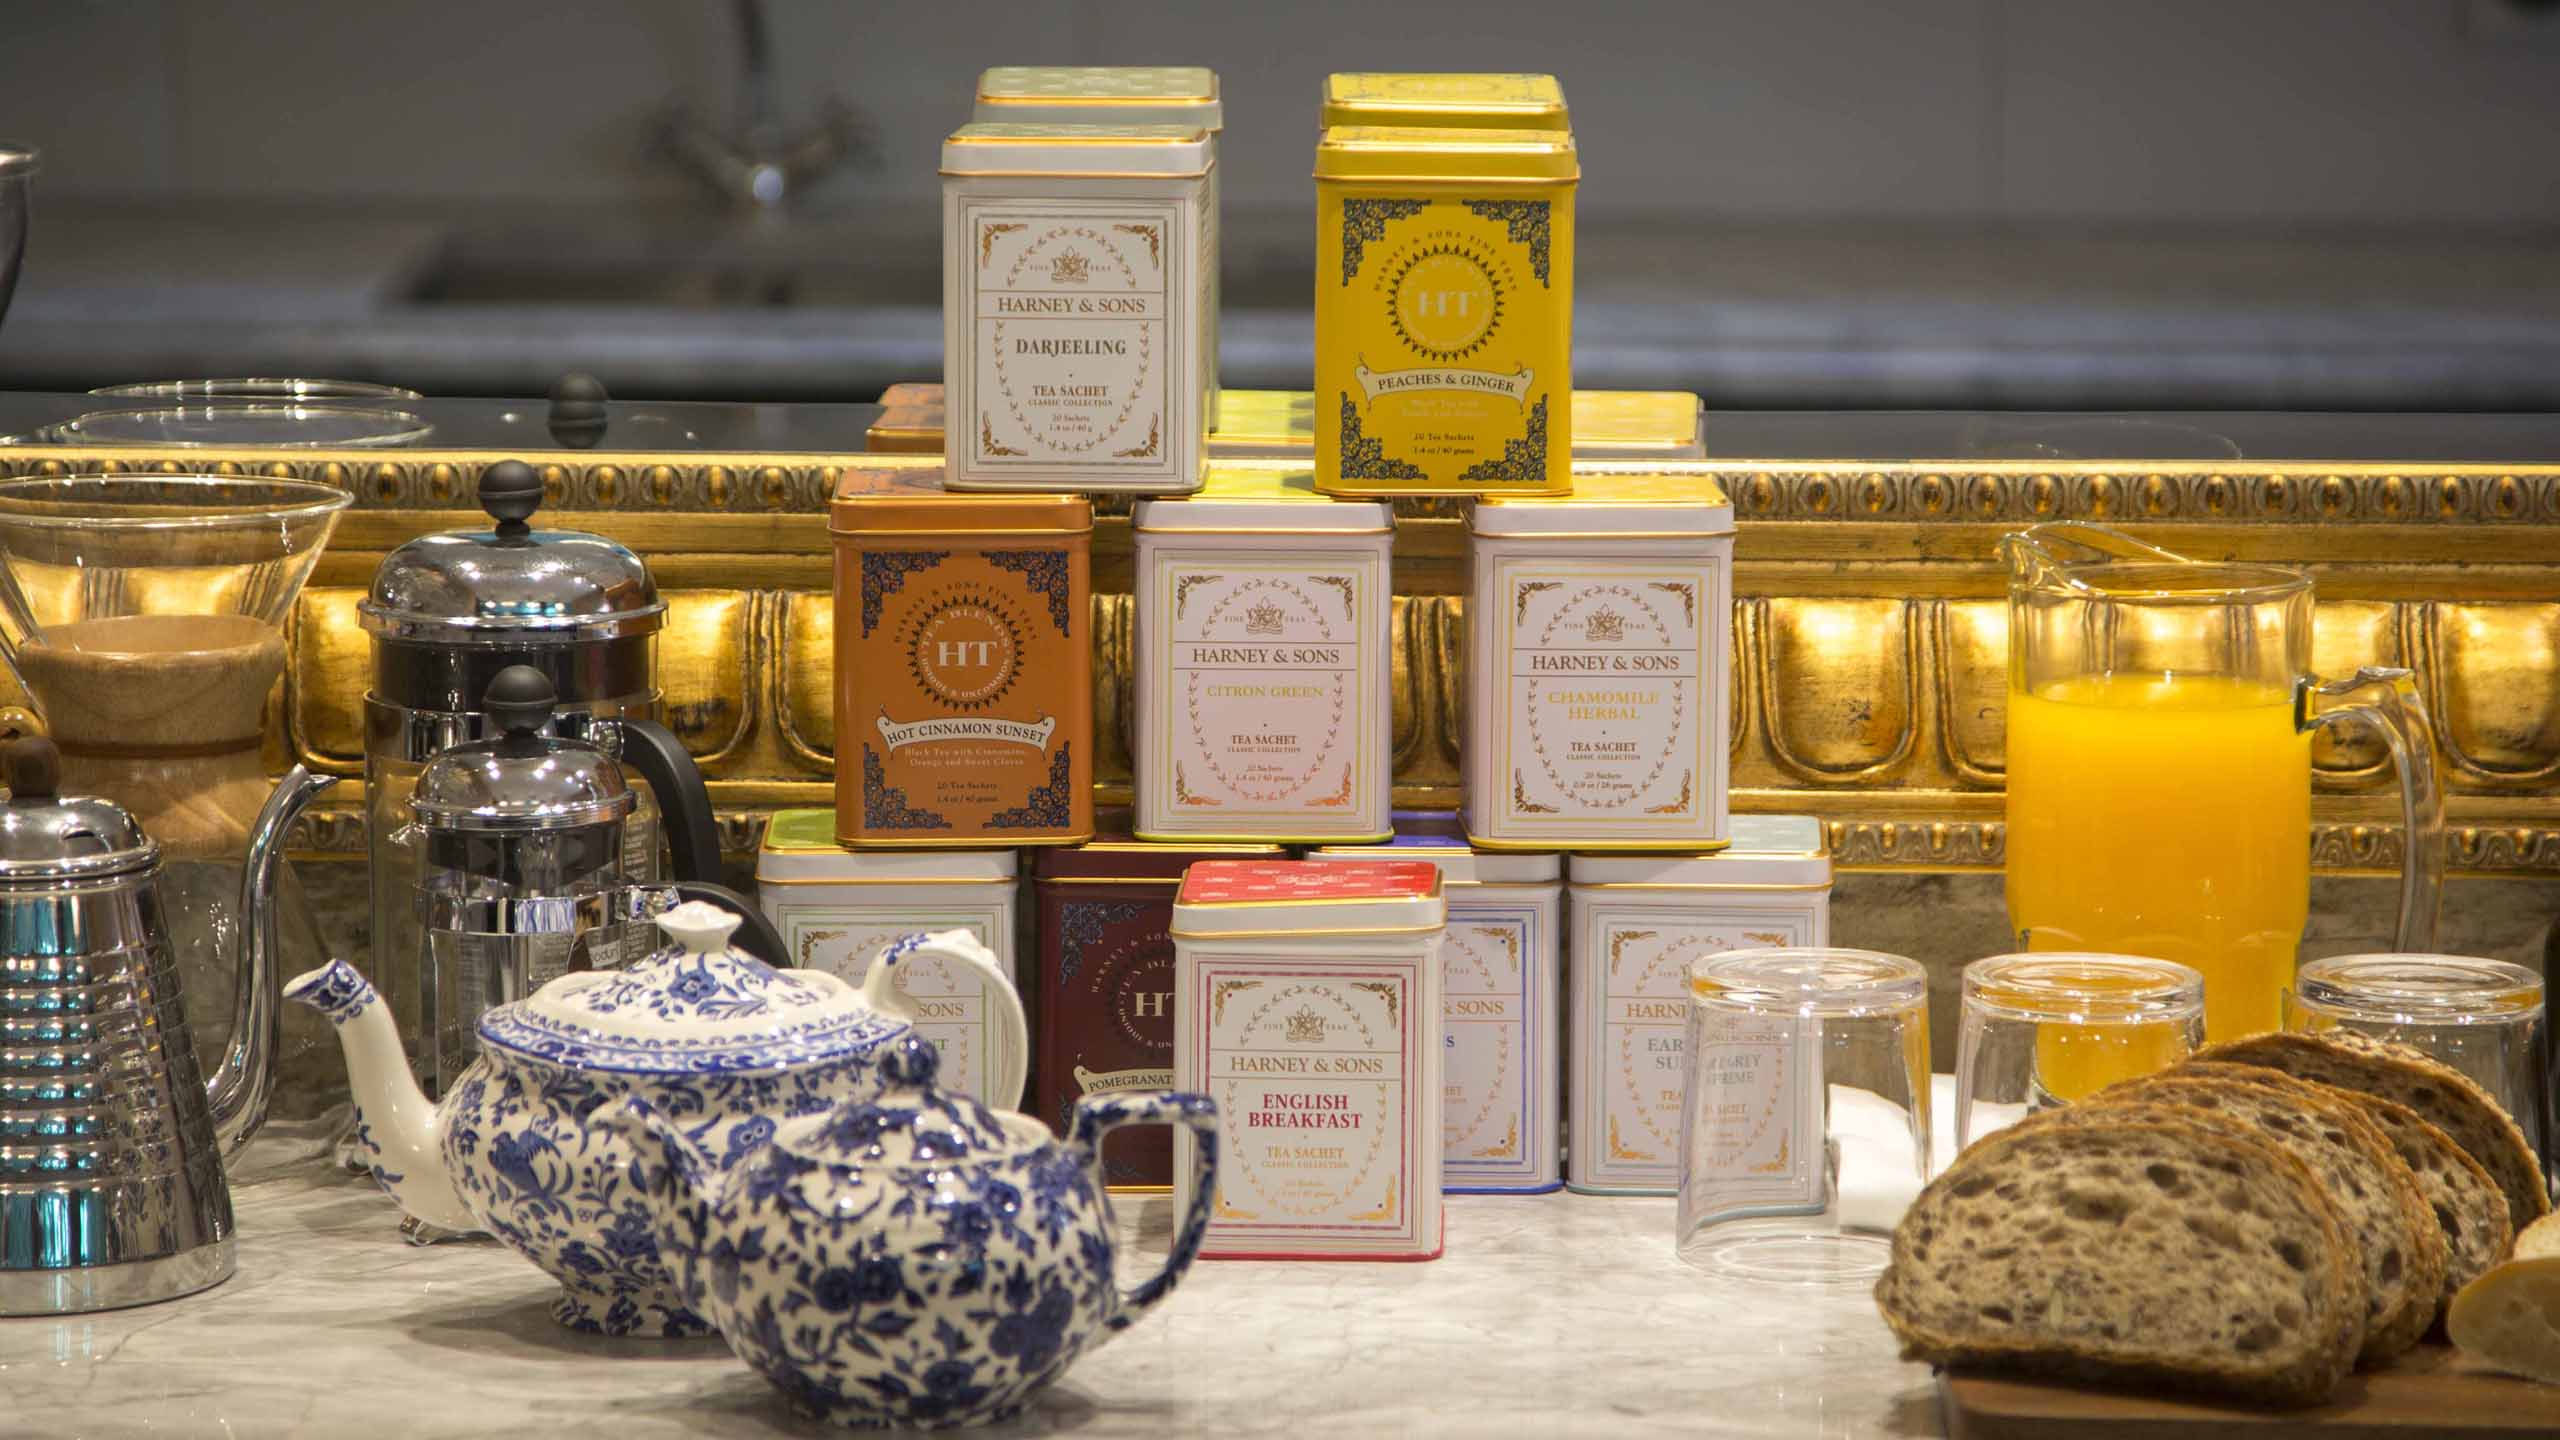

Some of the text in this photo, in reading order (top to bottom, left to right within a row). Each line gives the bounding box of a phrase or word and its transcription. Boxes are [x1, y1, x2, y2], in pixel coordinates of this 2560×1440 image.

[998, 297, 1146, 312] HARNEY & SONS
[1419, 291, 1479, 317] HT
[1016, 338, 1126, 357] DARJEELING
[1032, 385, 1108, 396] TEA SACHET
[1378, 374, 1515, 393] PEACHES & GINGER
[937, 641, 998, 666] HT
[1192, 648, 1340, 663] HARNEY & SONS
[1532, 656, 1679, 670] HARNEY & SONS
[1206, 686, 1324, 697] CITRON GREEN
[1547, 692, 1659, 704] CHAMOMILE
[1568, 708, 1640, 719] HERBAL
[887, 722, 1047, 745] HOT CINNAMON SUNSET
[1232, 735, 1297, 745] TEA SACHET
[1571, 742, 1637, 752] TEA SACHET
[1146, 933, 1171, 941] SON
[918, 1003, 965, 1017] SONS
[1456, 1000, 1504, 1015] SONS
[1648, 1039, 1683, 1051] EAR
[1231, 1056, 1383, 1073] HARNEY & SONS
[1088, 1075, 1173, 1092] POMEGRANAT
[1264, 1094, 1348, 1110] ENGLISH
[1248, 1112, 1362, 1128] BREAKFAST
[1266, 1146, 1344, 1158] TEA SACHET
